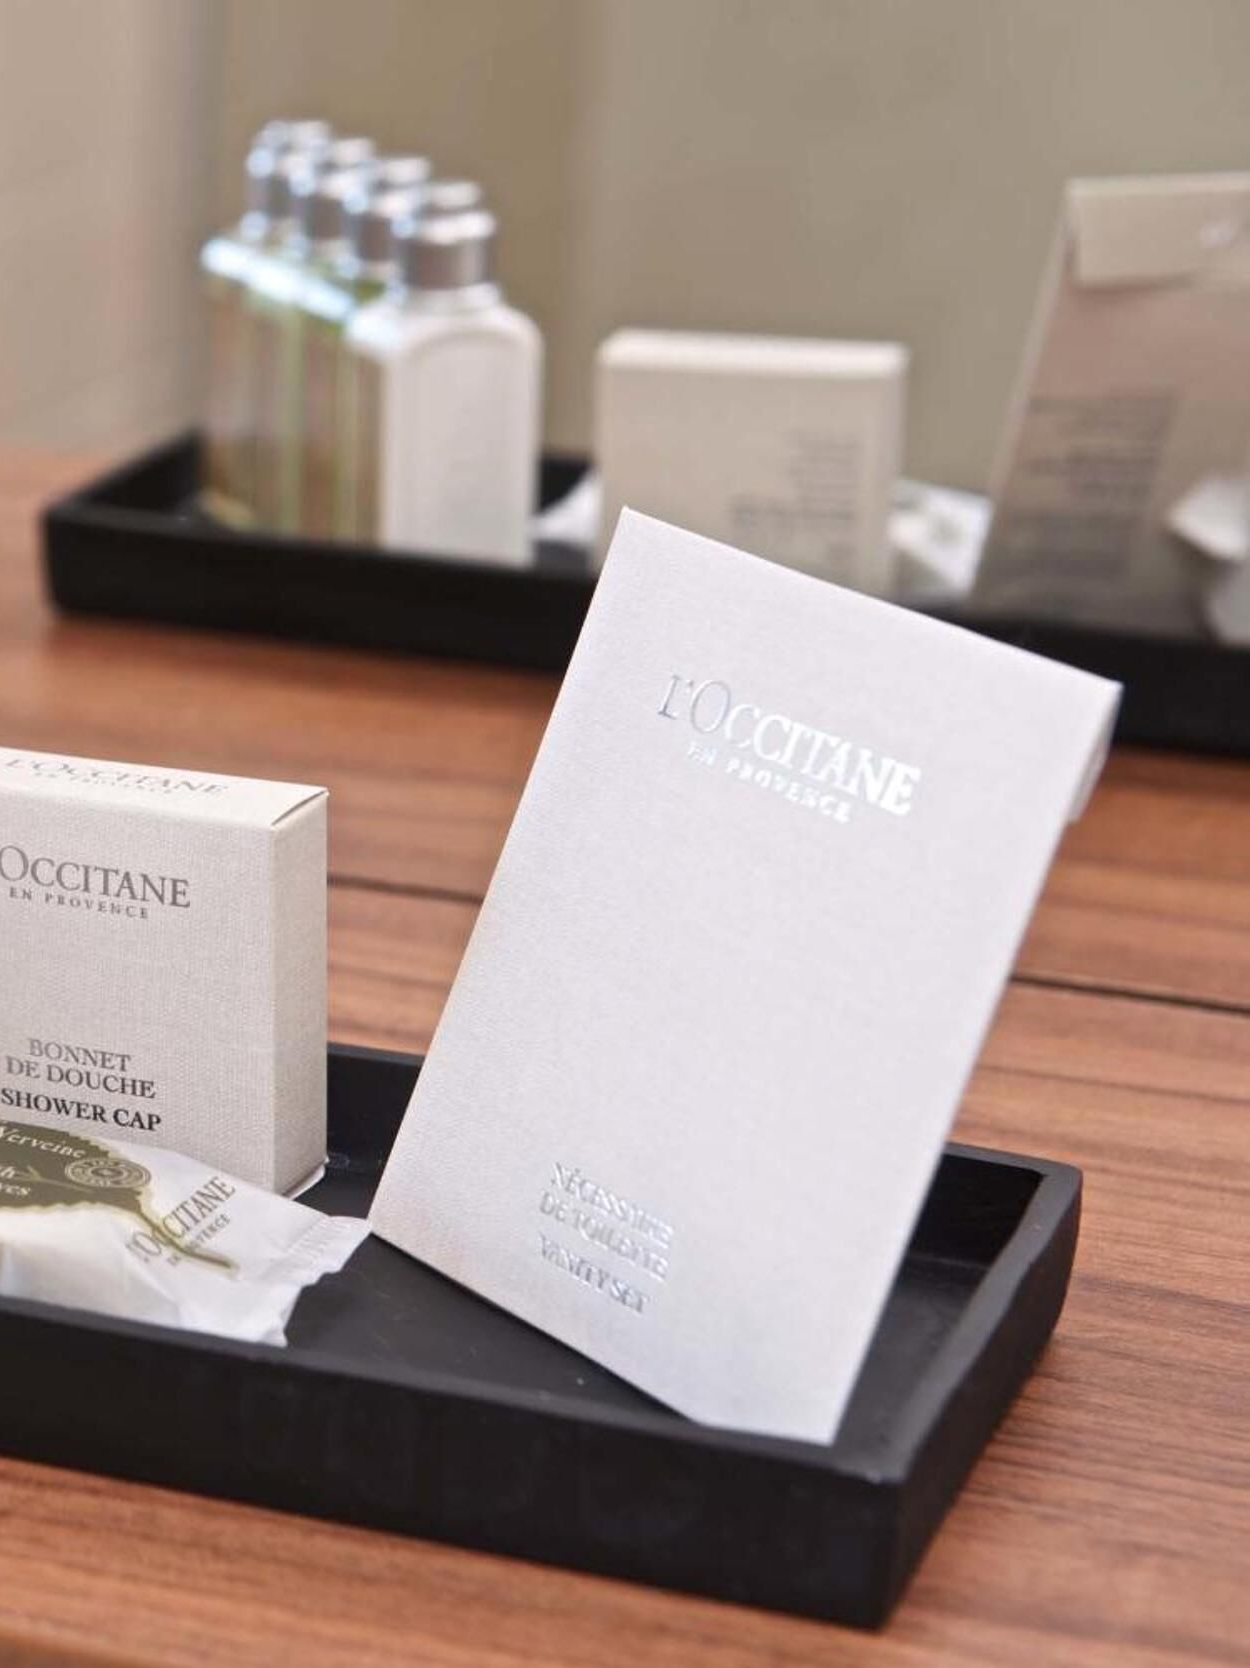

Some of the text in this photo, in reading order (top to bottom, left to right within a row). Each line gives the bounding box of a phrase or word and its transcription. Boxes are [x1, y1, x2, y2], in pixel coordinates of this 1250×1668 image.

[658, 673, 922, 816] L'OCCITANE
[9, 886, 149, 920] EN PROVENCE
[28, 1038, 131, 1073] BONNET
[5, 1056, 157, 1099] DE DOUCHE
[0, 1087, 161, 1132] SHOWER CAP
